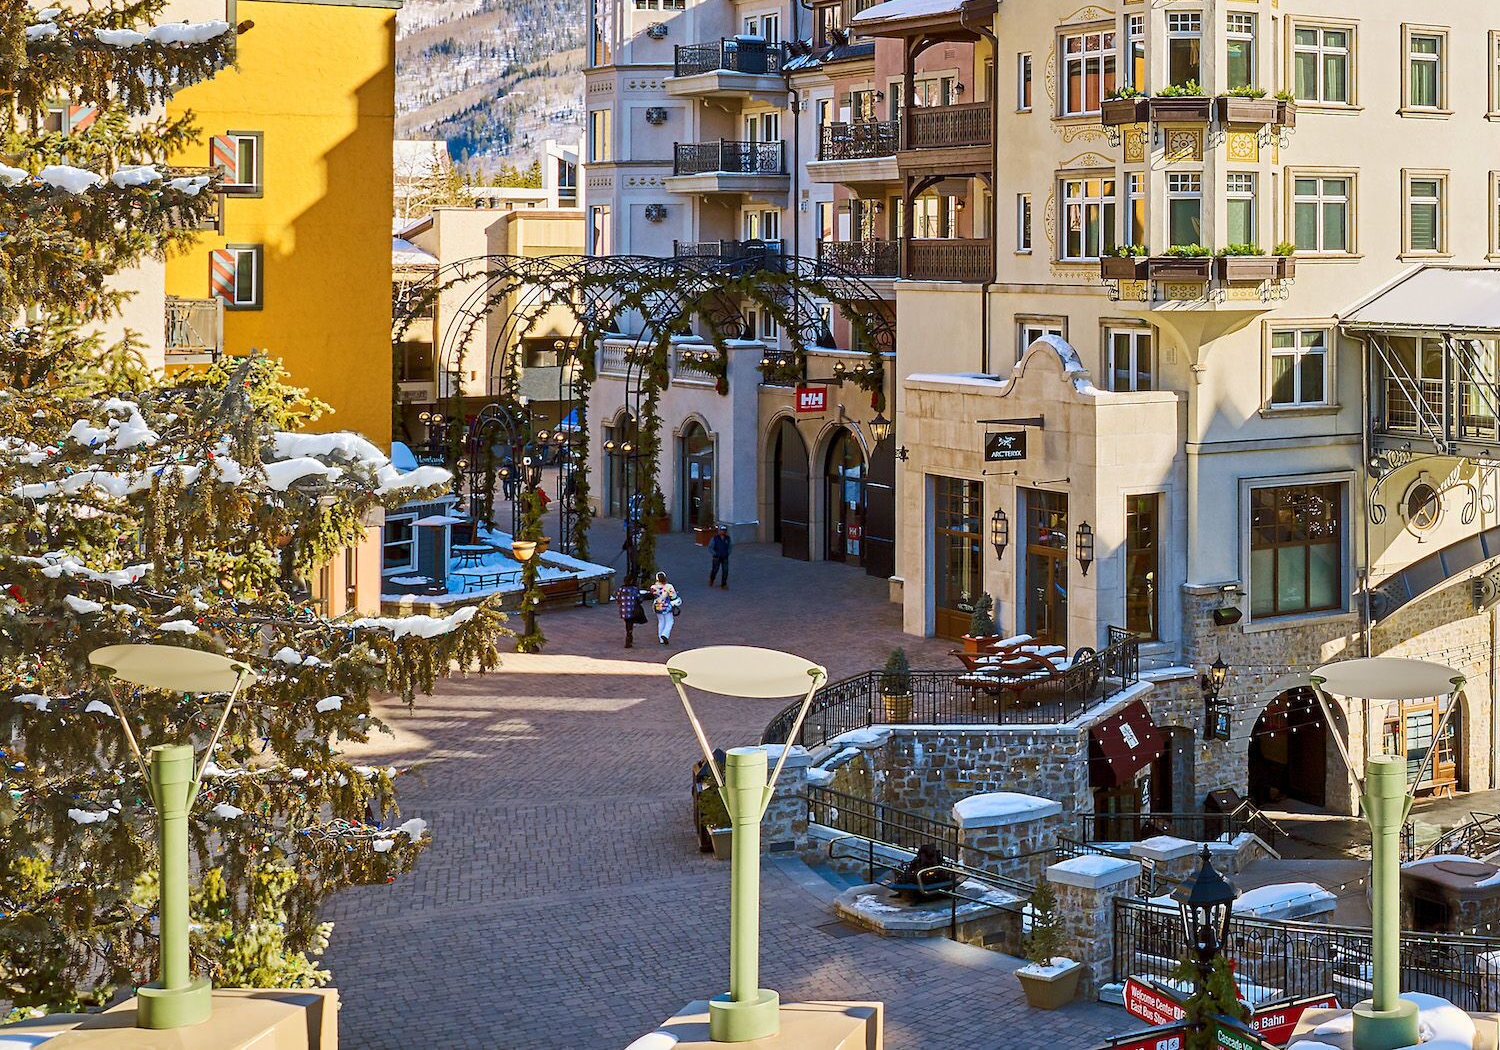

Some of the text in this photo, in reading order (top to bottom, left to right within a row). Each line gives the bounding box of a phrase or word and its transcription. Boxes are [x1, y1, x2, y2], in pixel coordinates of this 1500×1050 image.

[1131, 985, 1155, 1007] Welcome
[1156, 998, 1173, 1016] Center
[1131, 999, 1142, 1015] East
[1143, 1006, 1153, 1020] Bus
[1261, 1015, 1285, 1029] Bahn
[1217, 1030, 1242, 1050] Cascade
